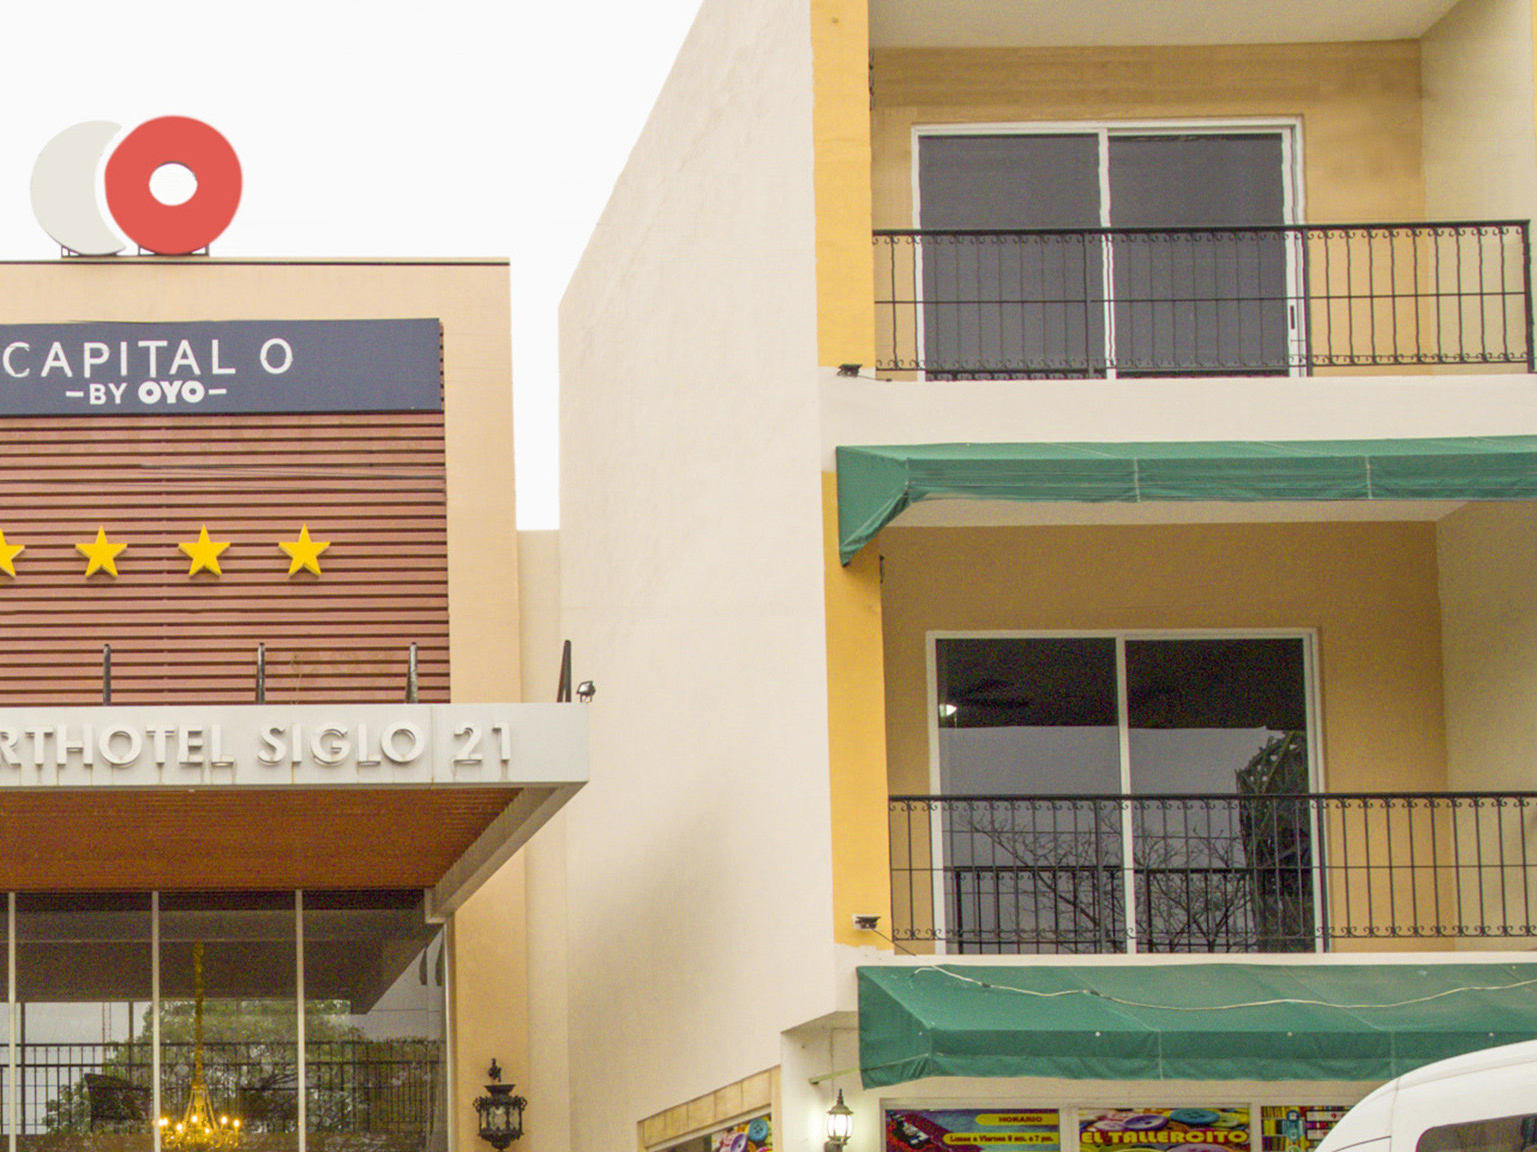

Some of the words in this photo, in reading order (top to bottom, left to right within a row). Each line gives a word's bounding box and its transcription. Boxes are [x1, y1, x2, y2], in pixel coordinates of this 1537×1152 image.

[2, 339, 236, 378] CAPITAL
[259, 337, 294, 374] O
[257, 721, 426, 767] SIGLO
[453, 720, 511, 765] 21
[1081, 1131, 1104, 1143] EL
[1108, 1130, 1249, 1144] TALLERCITO
